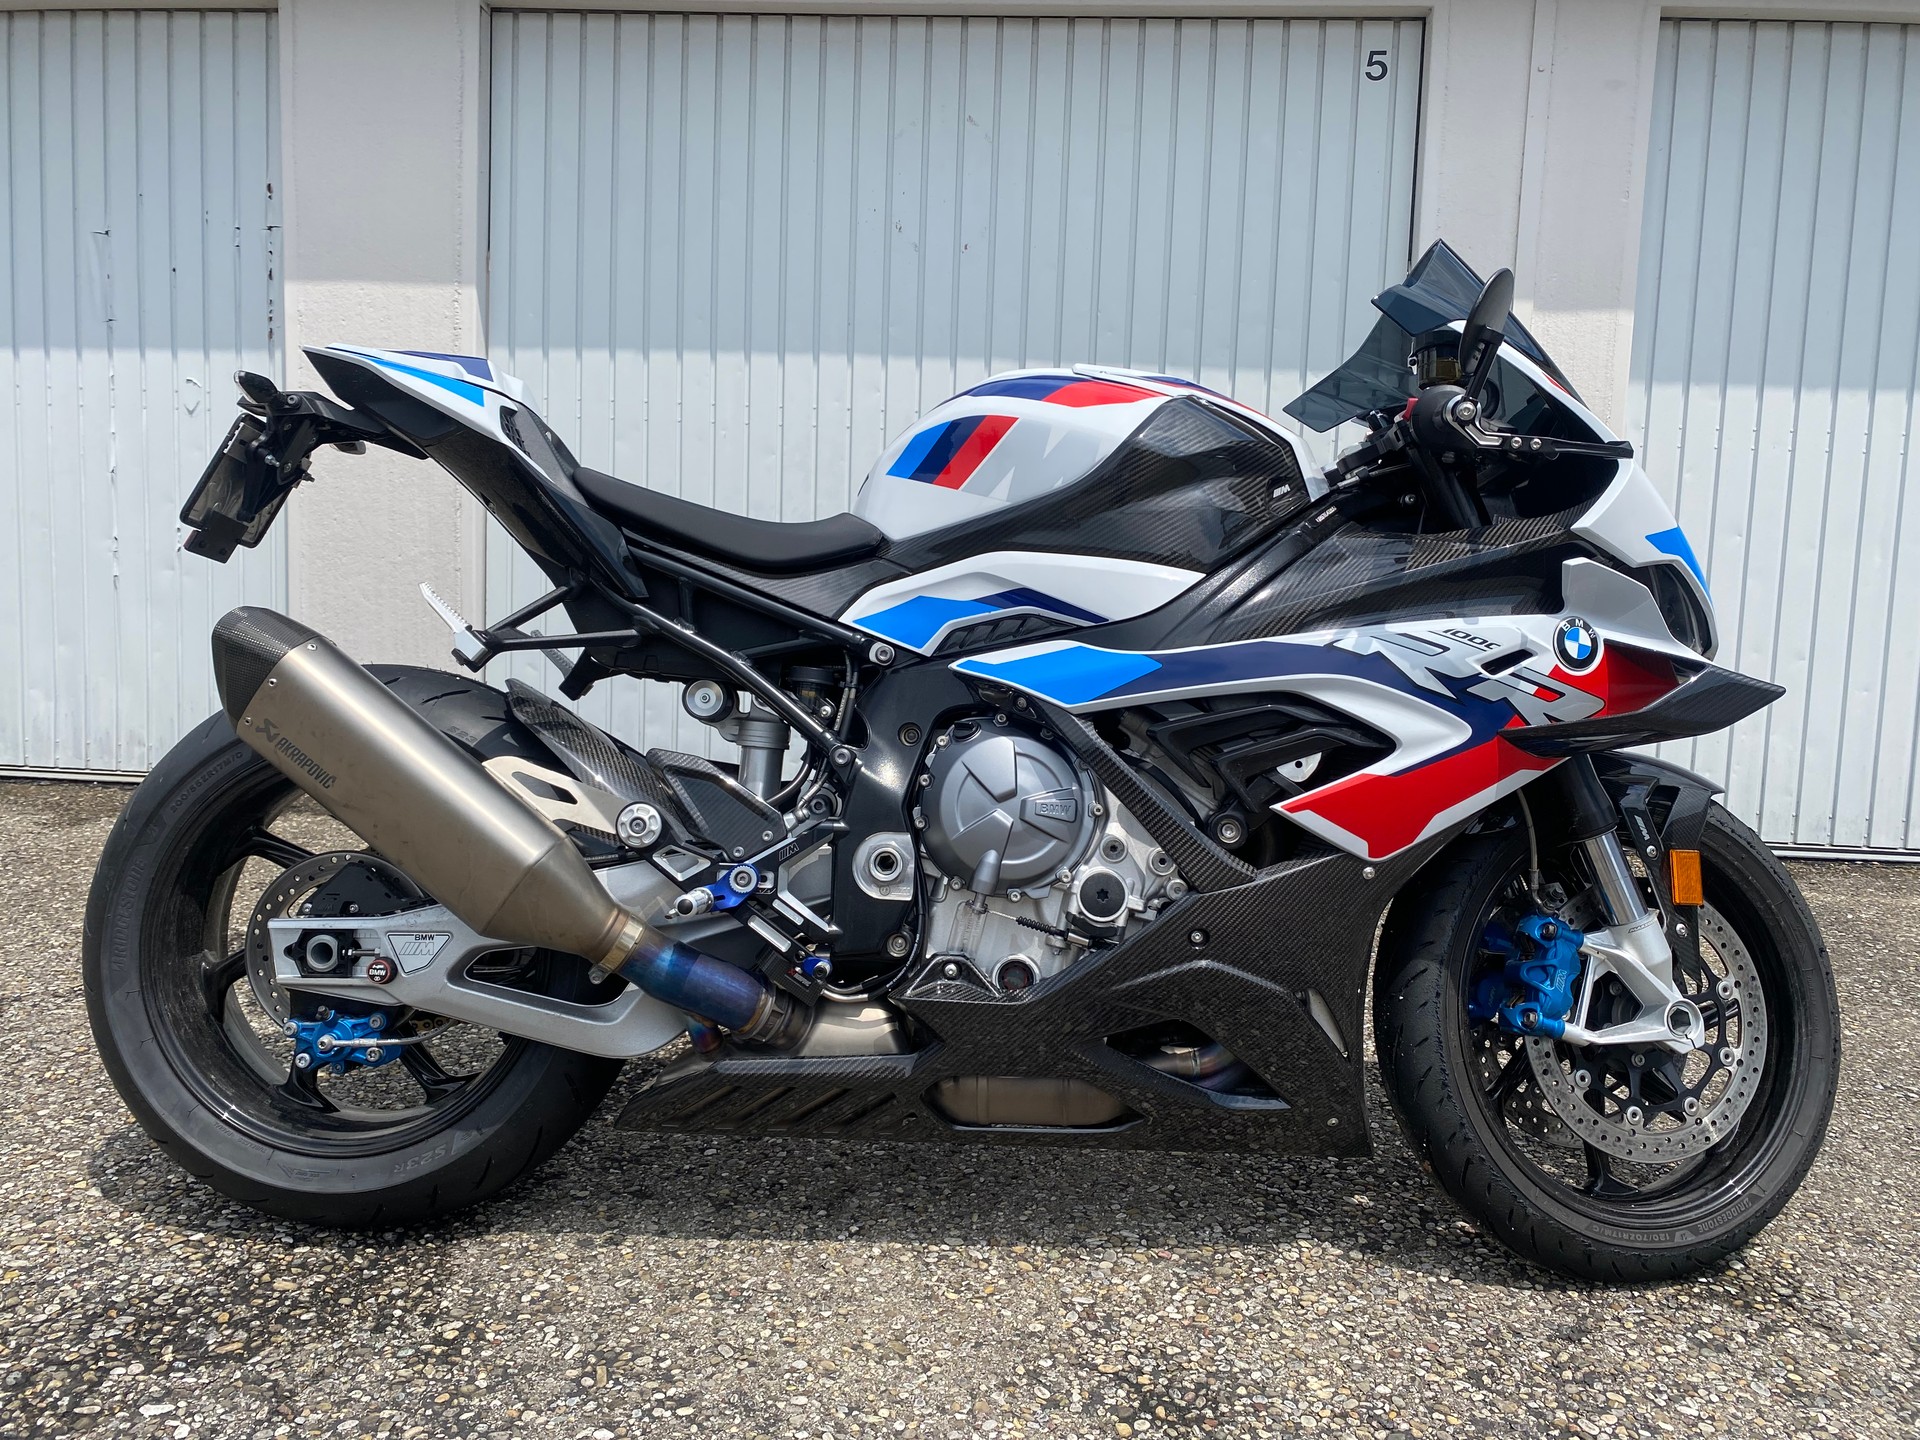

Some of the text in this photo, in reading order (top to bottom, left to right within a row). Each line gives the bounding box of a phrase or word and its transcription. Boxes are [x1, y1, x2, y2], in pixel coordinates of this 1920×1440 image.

[1365, 50, 1388, 81] 5
[1561, 618, 1596, 639] BMW
[1040, 803, 1072, 815] BMW
[414, 933, 435, 941] BMW
